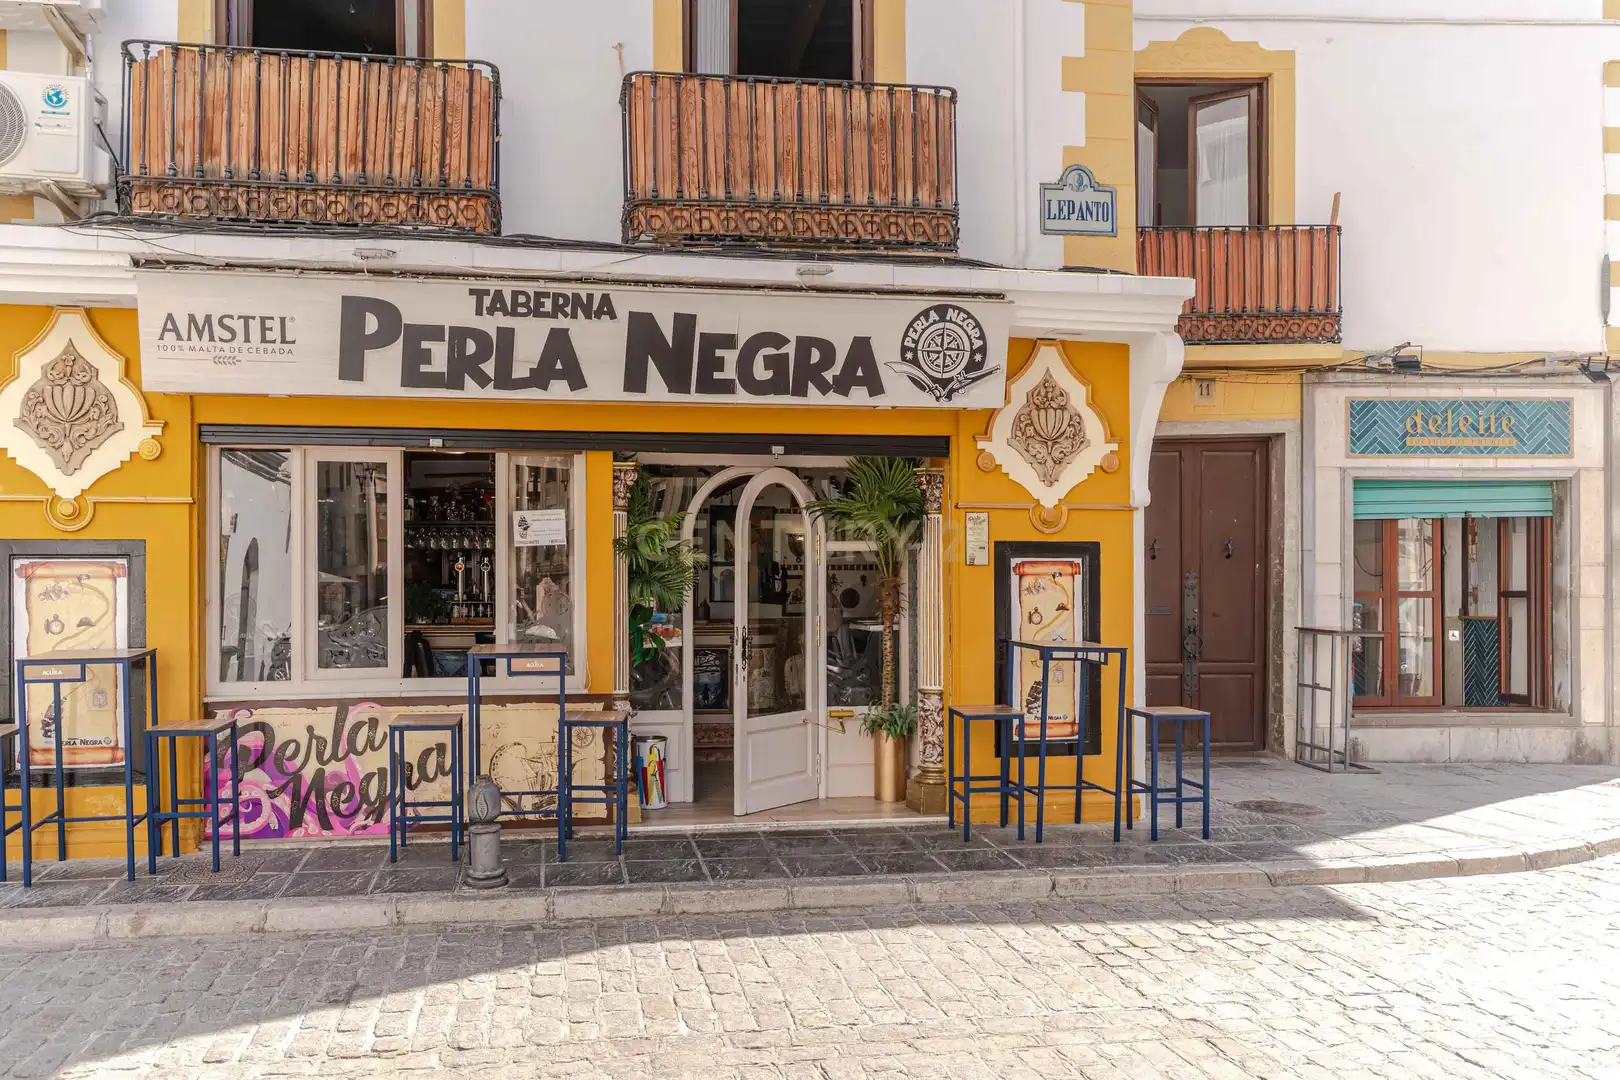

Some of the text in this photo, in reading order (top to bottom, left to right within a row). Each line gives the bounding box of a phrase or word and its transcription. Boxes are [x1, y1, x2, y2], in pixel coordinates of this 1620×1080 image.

[1046, 199, 1109, 222] LEPANTO
[468, 288, 618, 321] TABERNA
[903, 307, 984, 350] PERLA NEGRA
[156, 344, 294, 355] 100% MALTA DE CEBADA
[338, 295, 886, 399] PERLA NEGRA
[1198, 383, 1210, 396] 11
[1404, 407, 1515, 434] deleite
[80, 738, 103, 746] NEGRA
[214, 700, 388, 785] Perla
